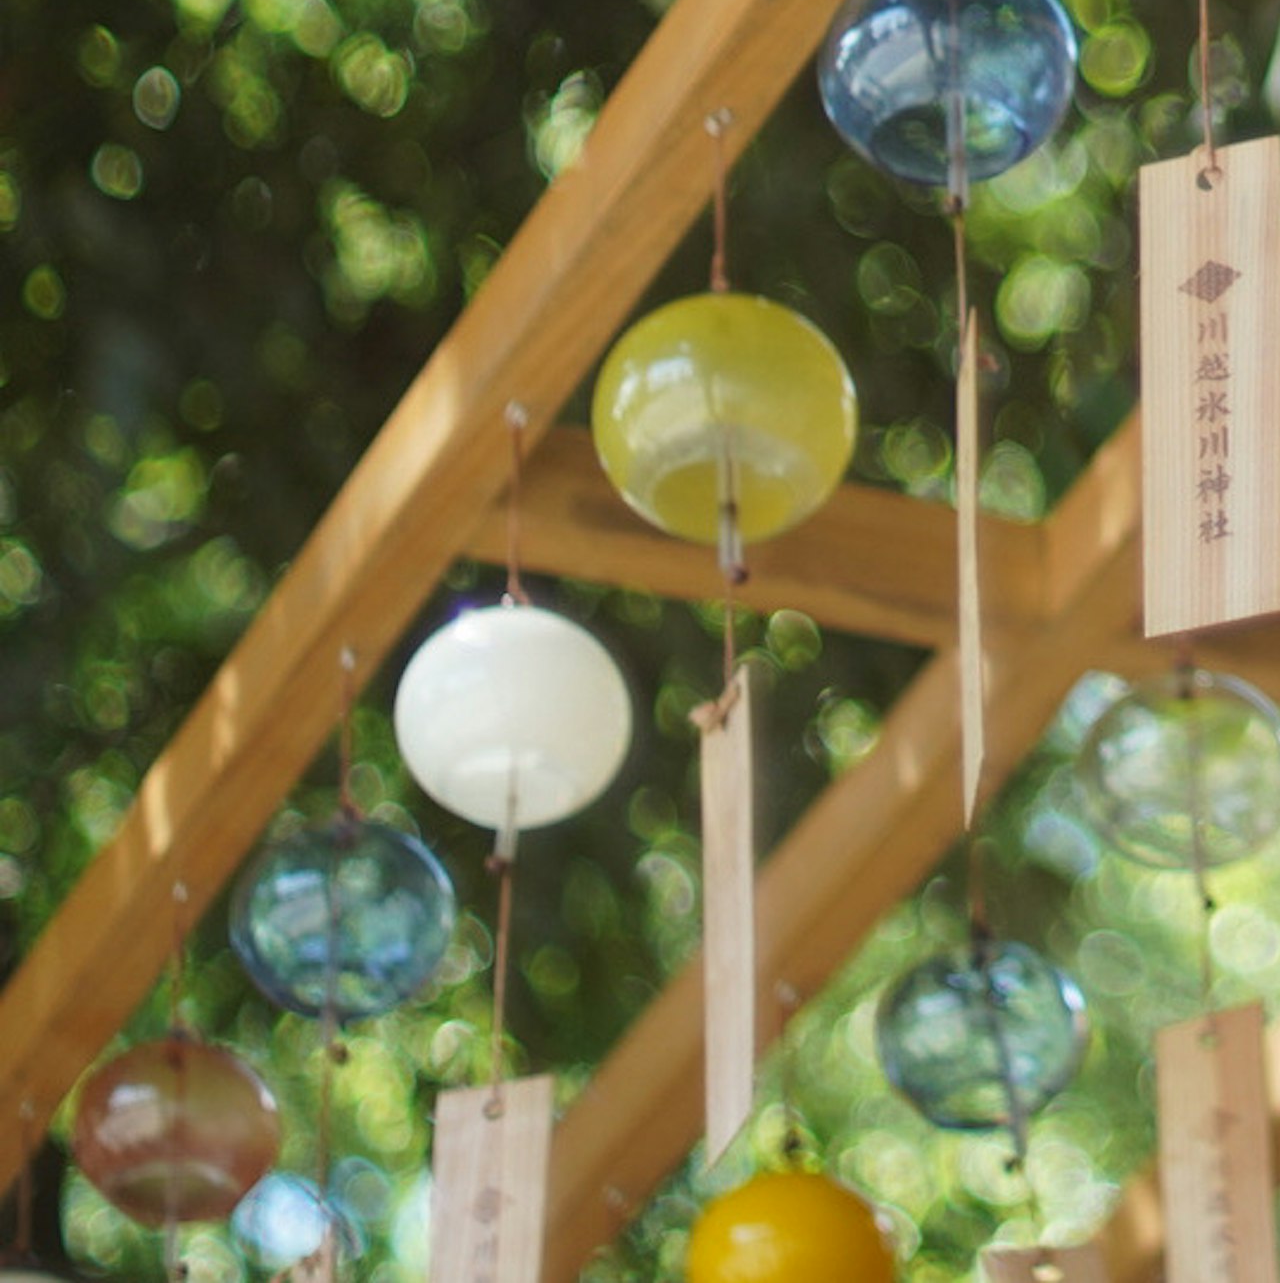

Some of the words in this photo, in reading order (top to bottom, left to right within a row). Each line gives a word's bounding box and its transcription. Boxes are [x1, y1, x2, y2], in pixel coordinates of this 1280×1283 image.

[1194, 312, 1235, 545] 川越氷川神社
